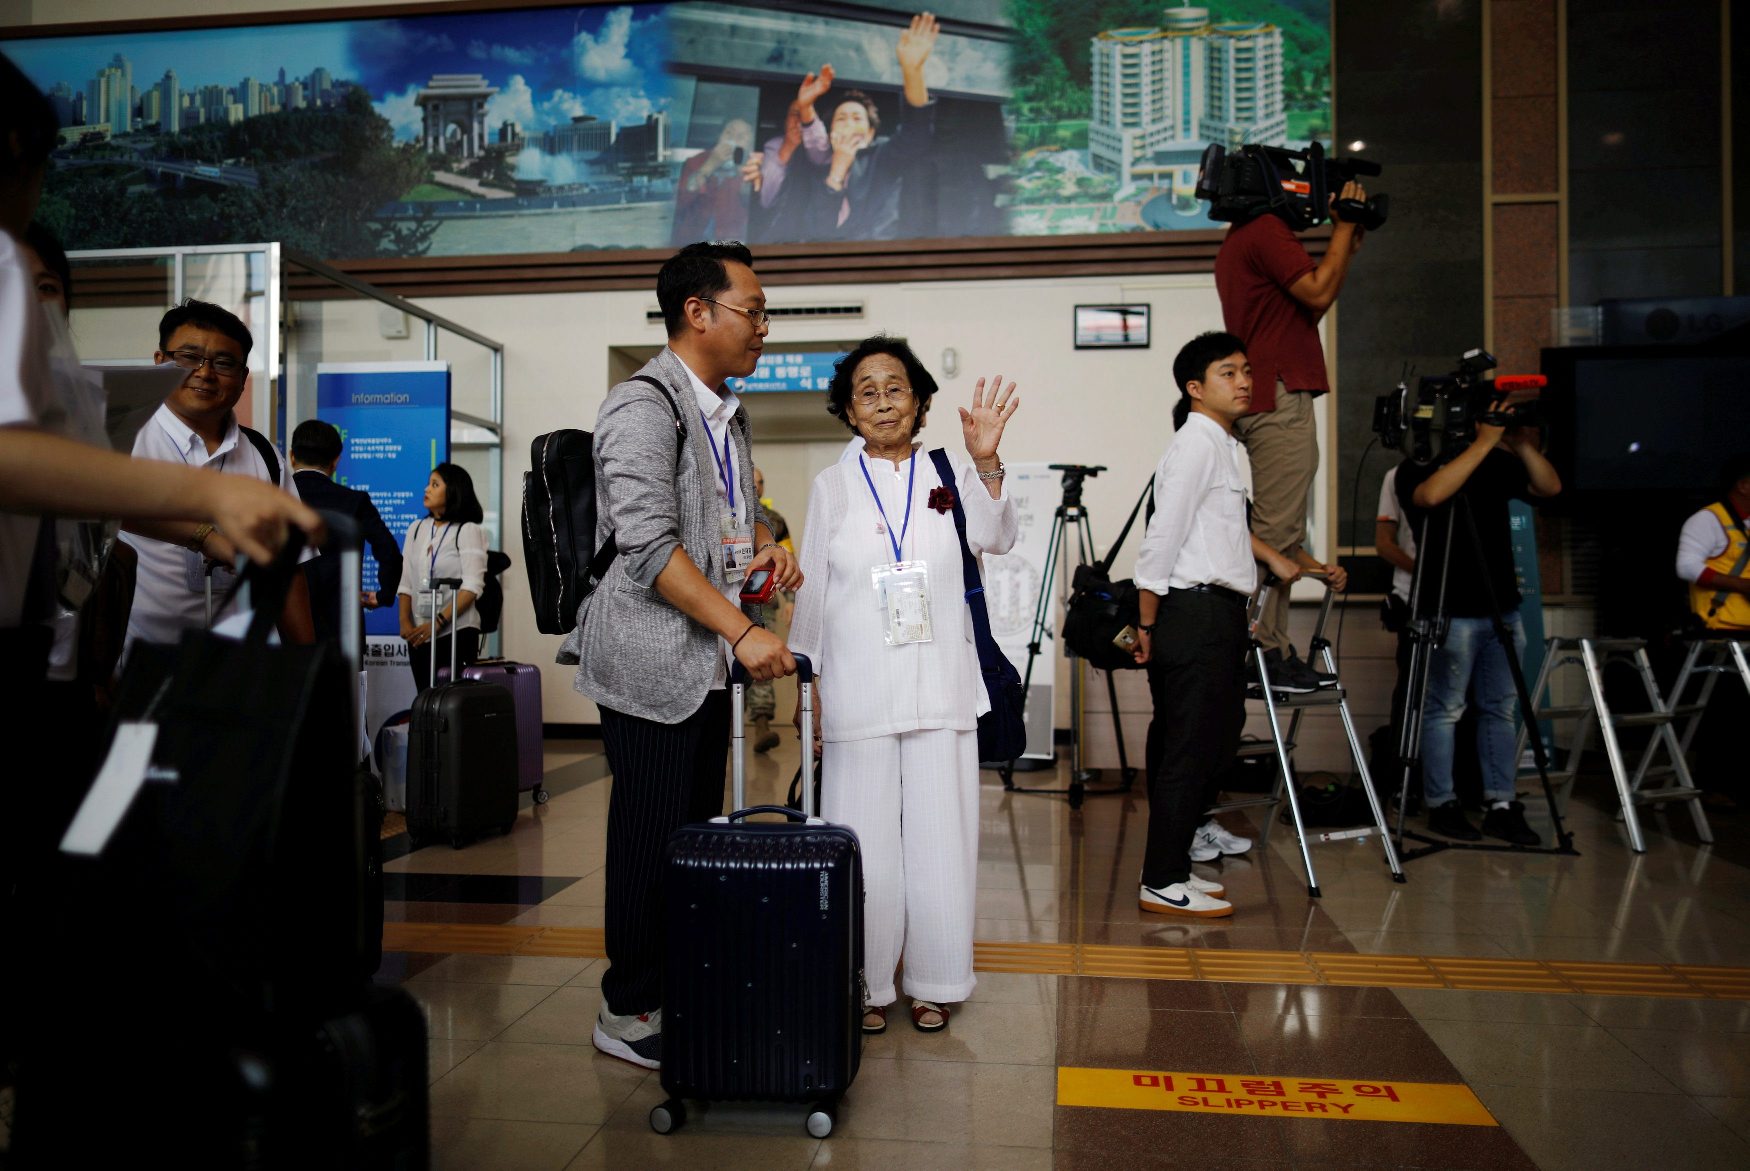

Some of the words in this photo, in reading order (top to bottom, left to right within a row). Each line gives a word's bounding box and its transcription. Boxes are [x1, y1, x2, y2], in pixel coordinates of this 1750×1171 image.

[351, 393, 409, 404] Information
[1132, 1074, 1400, 1103] 미끄럼주의
[1177, 1095, 1355, 1115] SLIPPERY
